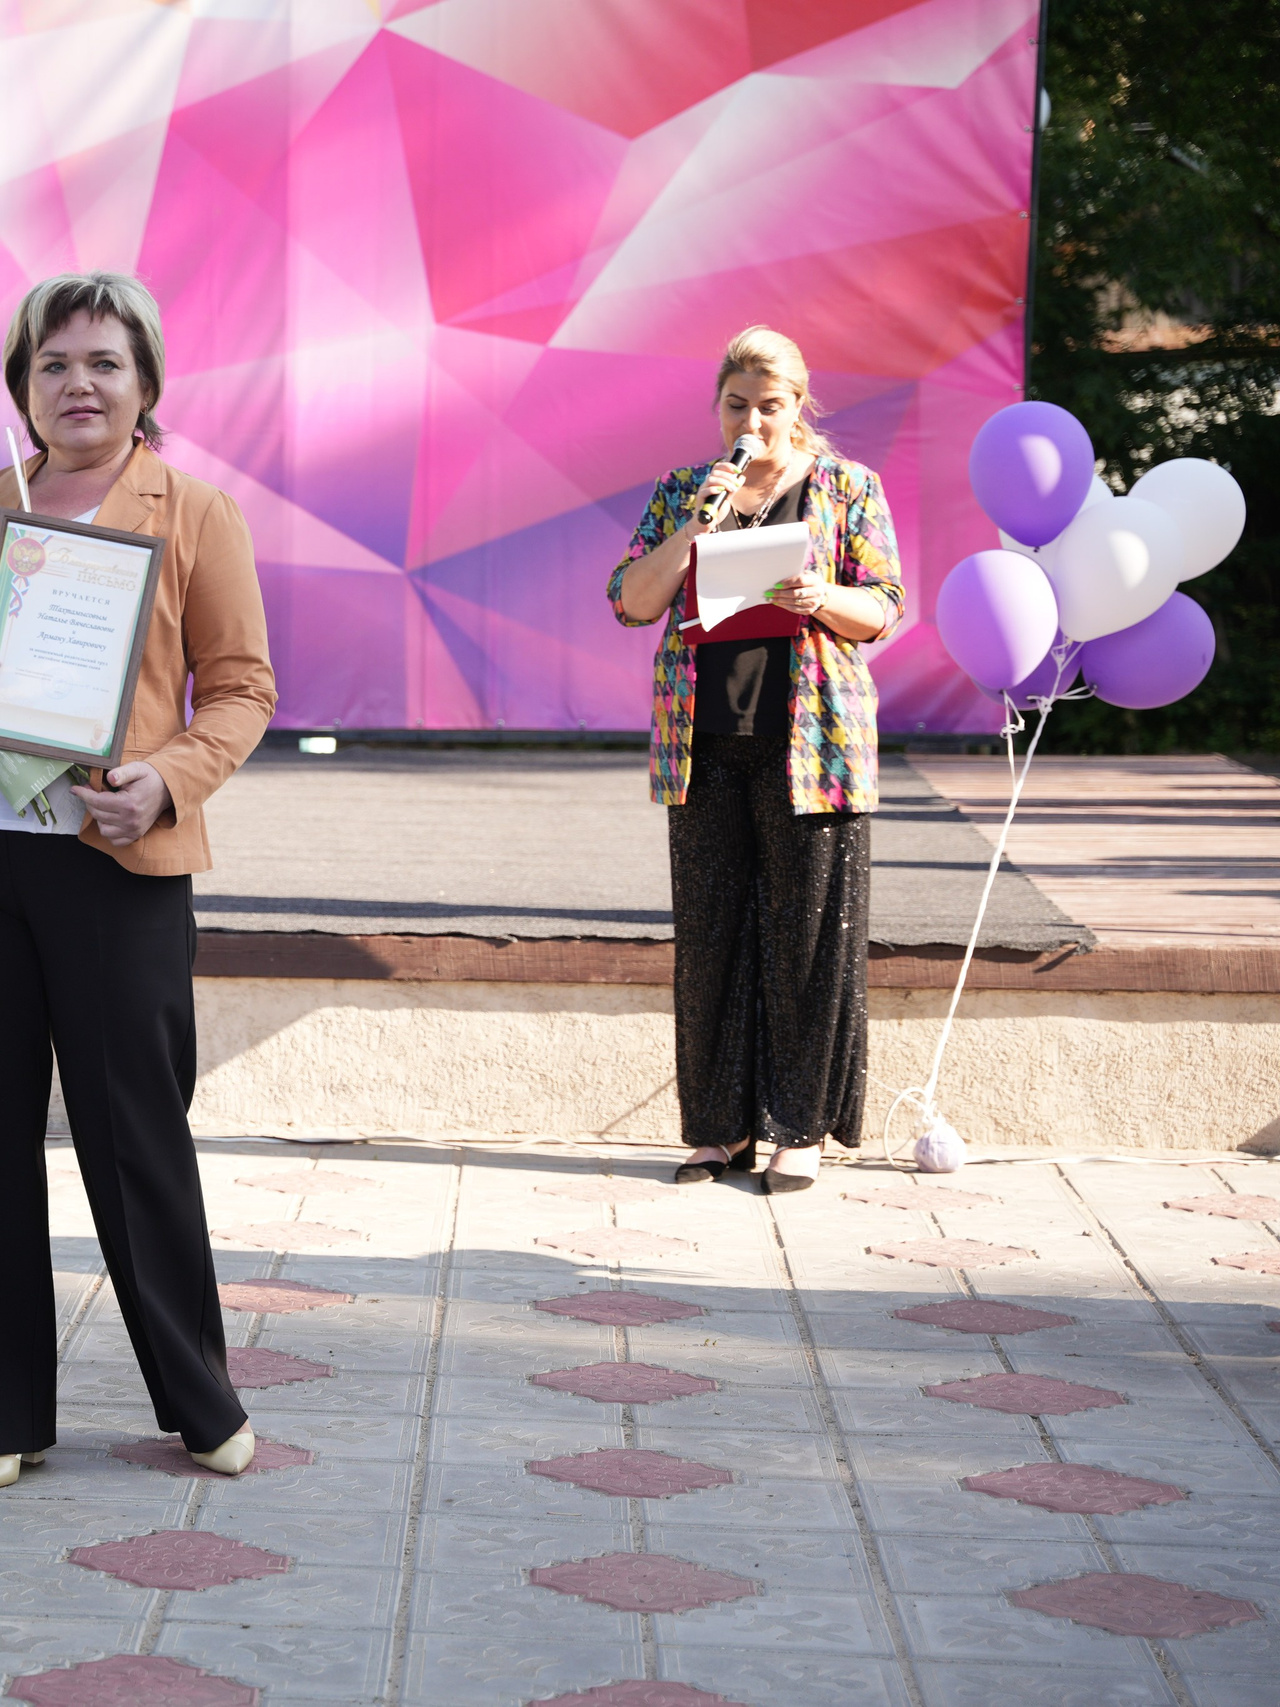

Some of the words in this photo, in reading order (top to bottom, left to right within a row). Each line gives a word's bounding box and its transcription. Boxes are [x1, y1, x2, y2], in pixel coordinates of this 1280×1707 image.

[76, 571, 136, 591] ПИСЬМО
[52, 588, 111, 606] ВРУЧАЕТСЯ
[36, 612, 69, 625] Наталье
[68, 618, 116, 633] Вячеславовне
[36, 631, 66, 645] Арману
